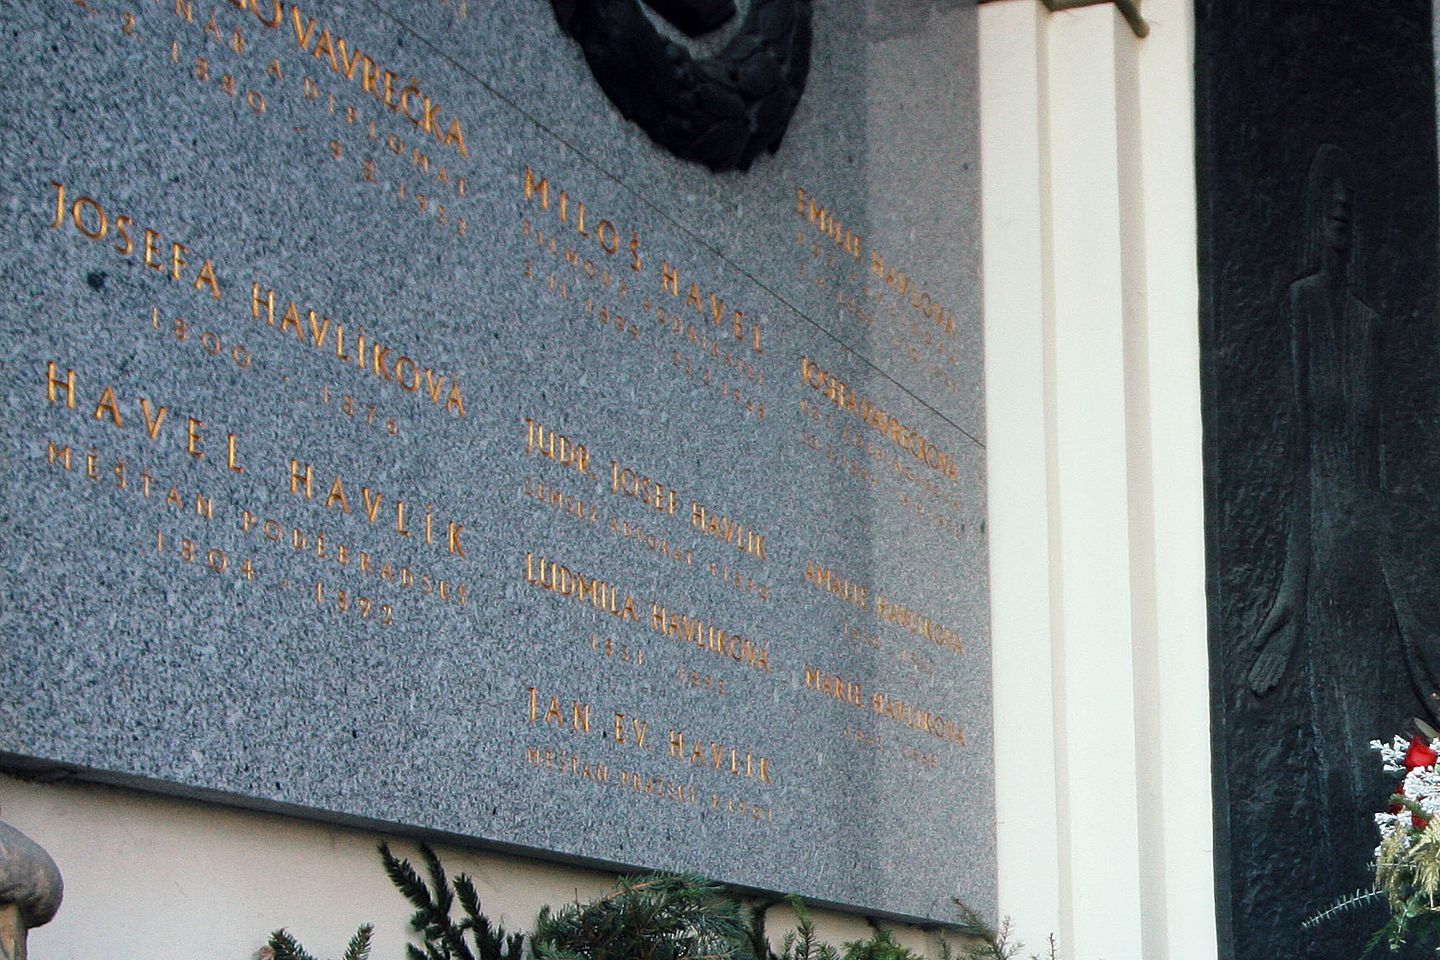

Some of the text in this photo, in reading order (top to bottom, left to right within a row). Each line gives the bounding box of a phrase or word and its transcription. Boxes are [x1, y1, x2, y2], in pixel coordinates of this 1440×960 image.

[292, 5, 468, 157] VAVREČKA
[50, 180, 466, 417] JOSEFA HAVLÍKOVÁ
[524, 165, 642, 272] MILOŠ
[661, 259, 763, 354] HAVEL
[151, 307, 251, 368] 1800
[47, 360, 466, 558] HAVEL HAVLÍK
[525, 417, 598, 480] JUDR.
[609, 460, 677, 517] JOSEF
[156, 530, 254, 582] 1804
[527, 551, 640, 623] LUDMILA
[528, 687, 590, 733] JAN
[806, 662, 865, 708] MARIE
